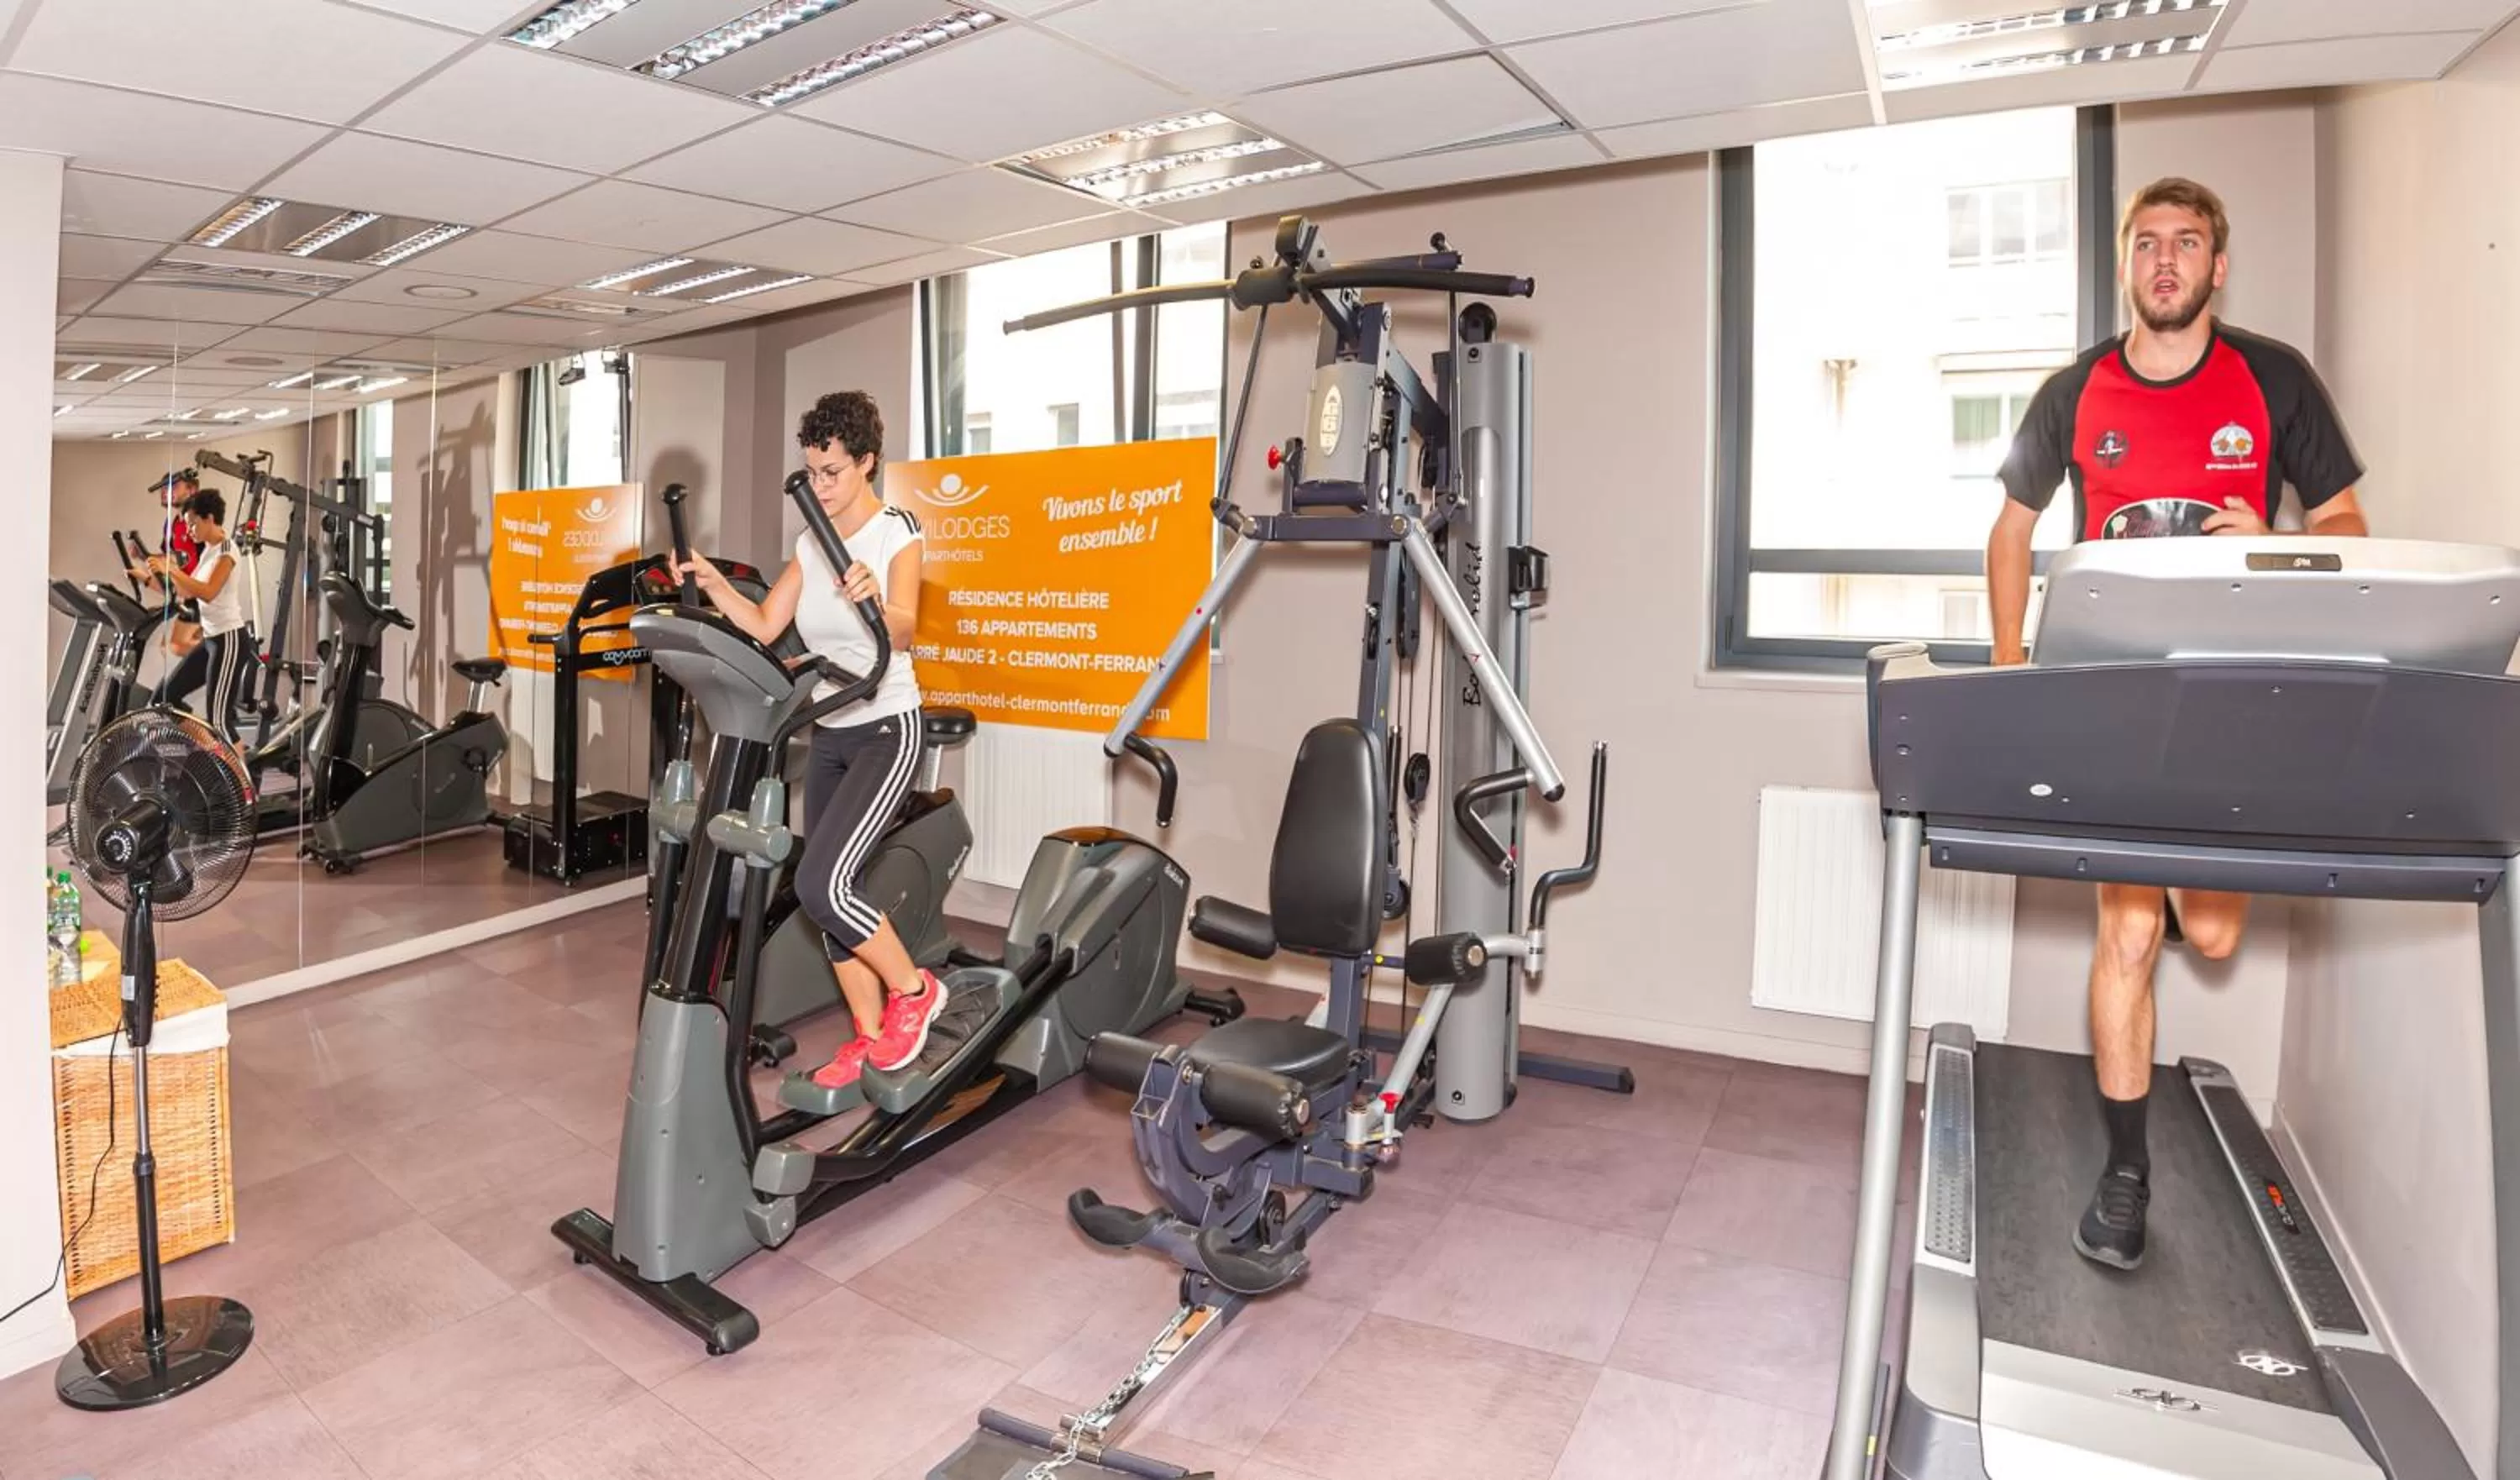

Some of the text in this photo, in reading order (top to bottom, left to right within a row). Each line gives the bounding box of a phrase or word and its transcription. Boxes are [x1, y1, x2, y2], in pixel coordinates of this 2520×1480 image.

[1043, 479, 1183, 521] Vivons le sport
[1059, 518, 1145, 553] ensemble
[948, 588, 1109, 609] RÉSIDENCE HÔTELIÈRE
[957, 619, 1097, 640] 136 APPARTEMENTS
[911, 642, 939, 660] ARRÉ
[942, 646, 985, 664] JAUDE
[988, 648, 998, 665] 2
[1008, 649, 1161, 673] CLERMONT-FERRAN
